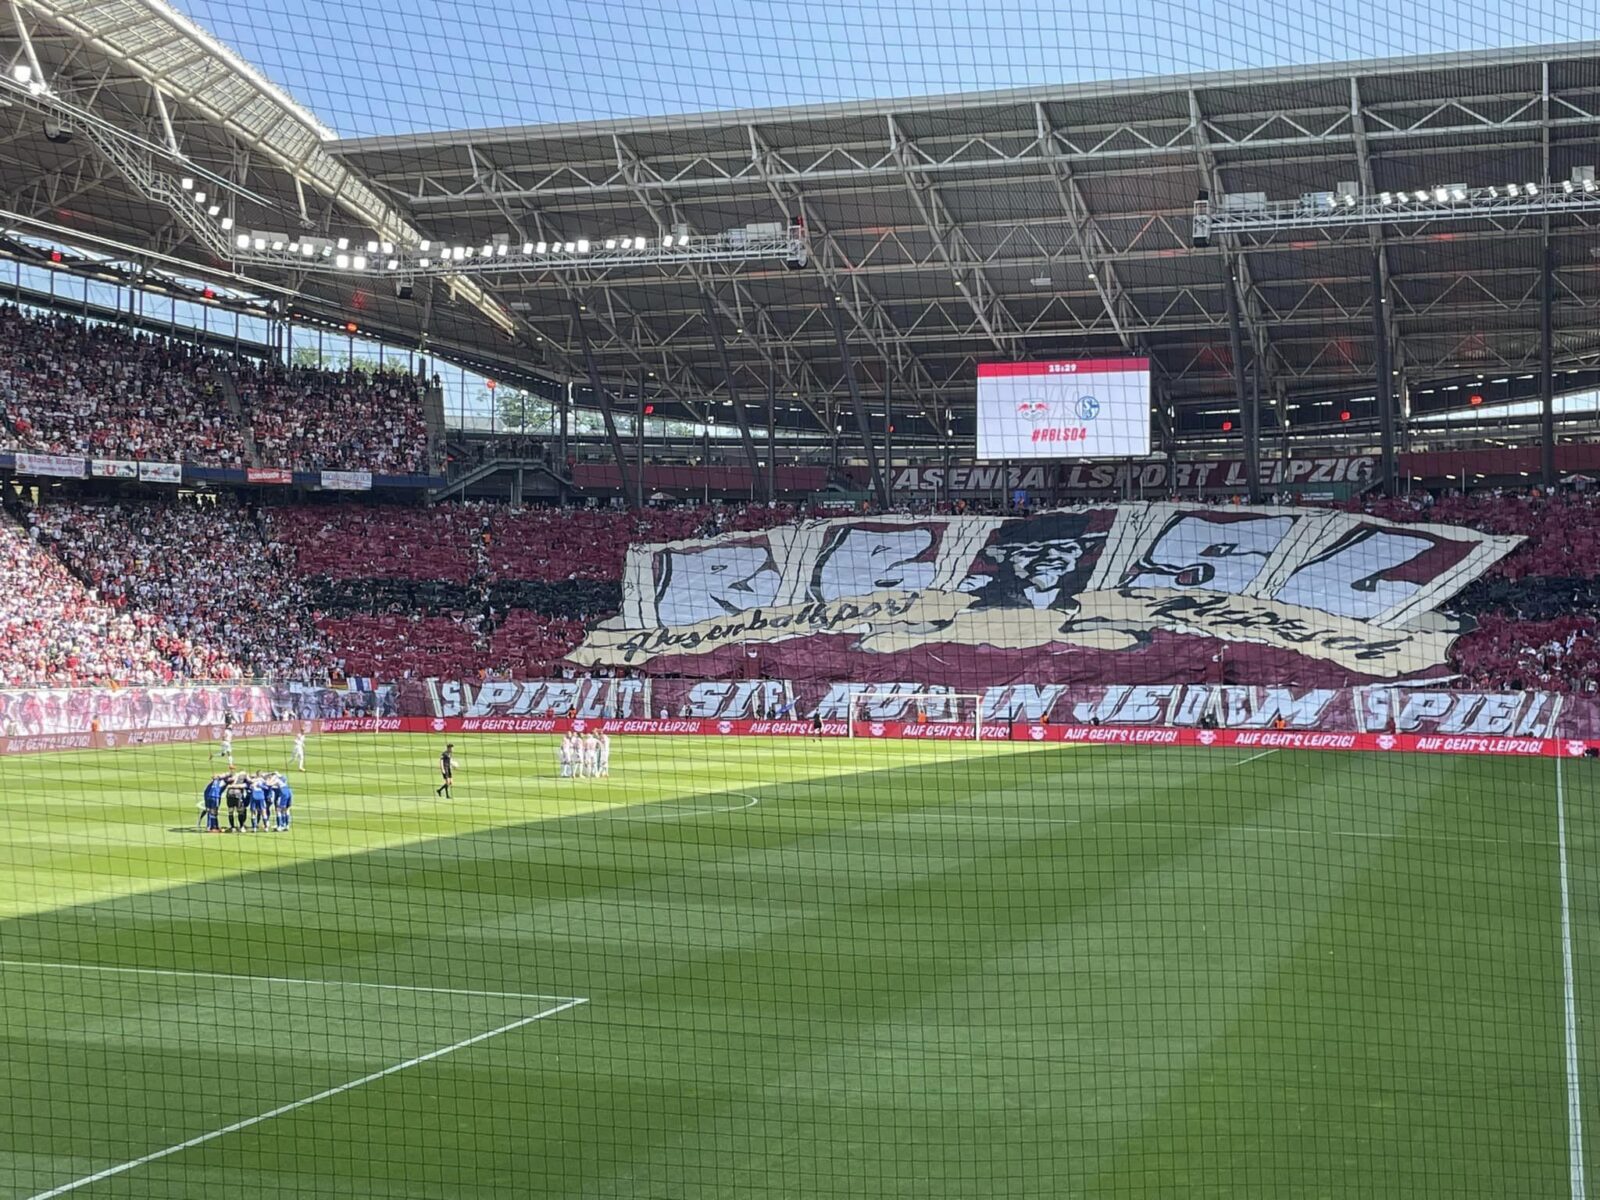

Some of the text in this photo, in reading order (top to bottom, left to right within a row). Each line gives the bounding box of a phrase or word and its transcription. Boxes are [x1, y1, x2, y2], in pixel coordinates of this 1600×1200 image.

[1031, 427, 1087, 442] #RBLS04
[1225, 456, 1375, 486] LEIPZIG
[440, 680, 1548, 738] SPIELT SIE AUS IN JEDEM SPIEL
[461, 719, 556, 732] AUF GEHT'S LEIPZIG!
[603, 721, 700, 732] AUF GEHT'S LEIPZIG!
[750, 722, 771, 733] AUF
[772, 722, 808, 734] GEHT'S
[903, 725, 926, 736] AUF
[926, 725, 964, 737] GEHT'S
[1064, 728, 1178, 743] AUF GEHT'S LEIPZIG!
[1235, 732, 1356, 748] AUF GEHT'S LEIPZIG!
[1416, 737, 1544, 753] AUF GEHT'S LEIPZIG!
